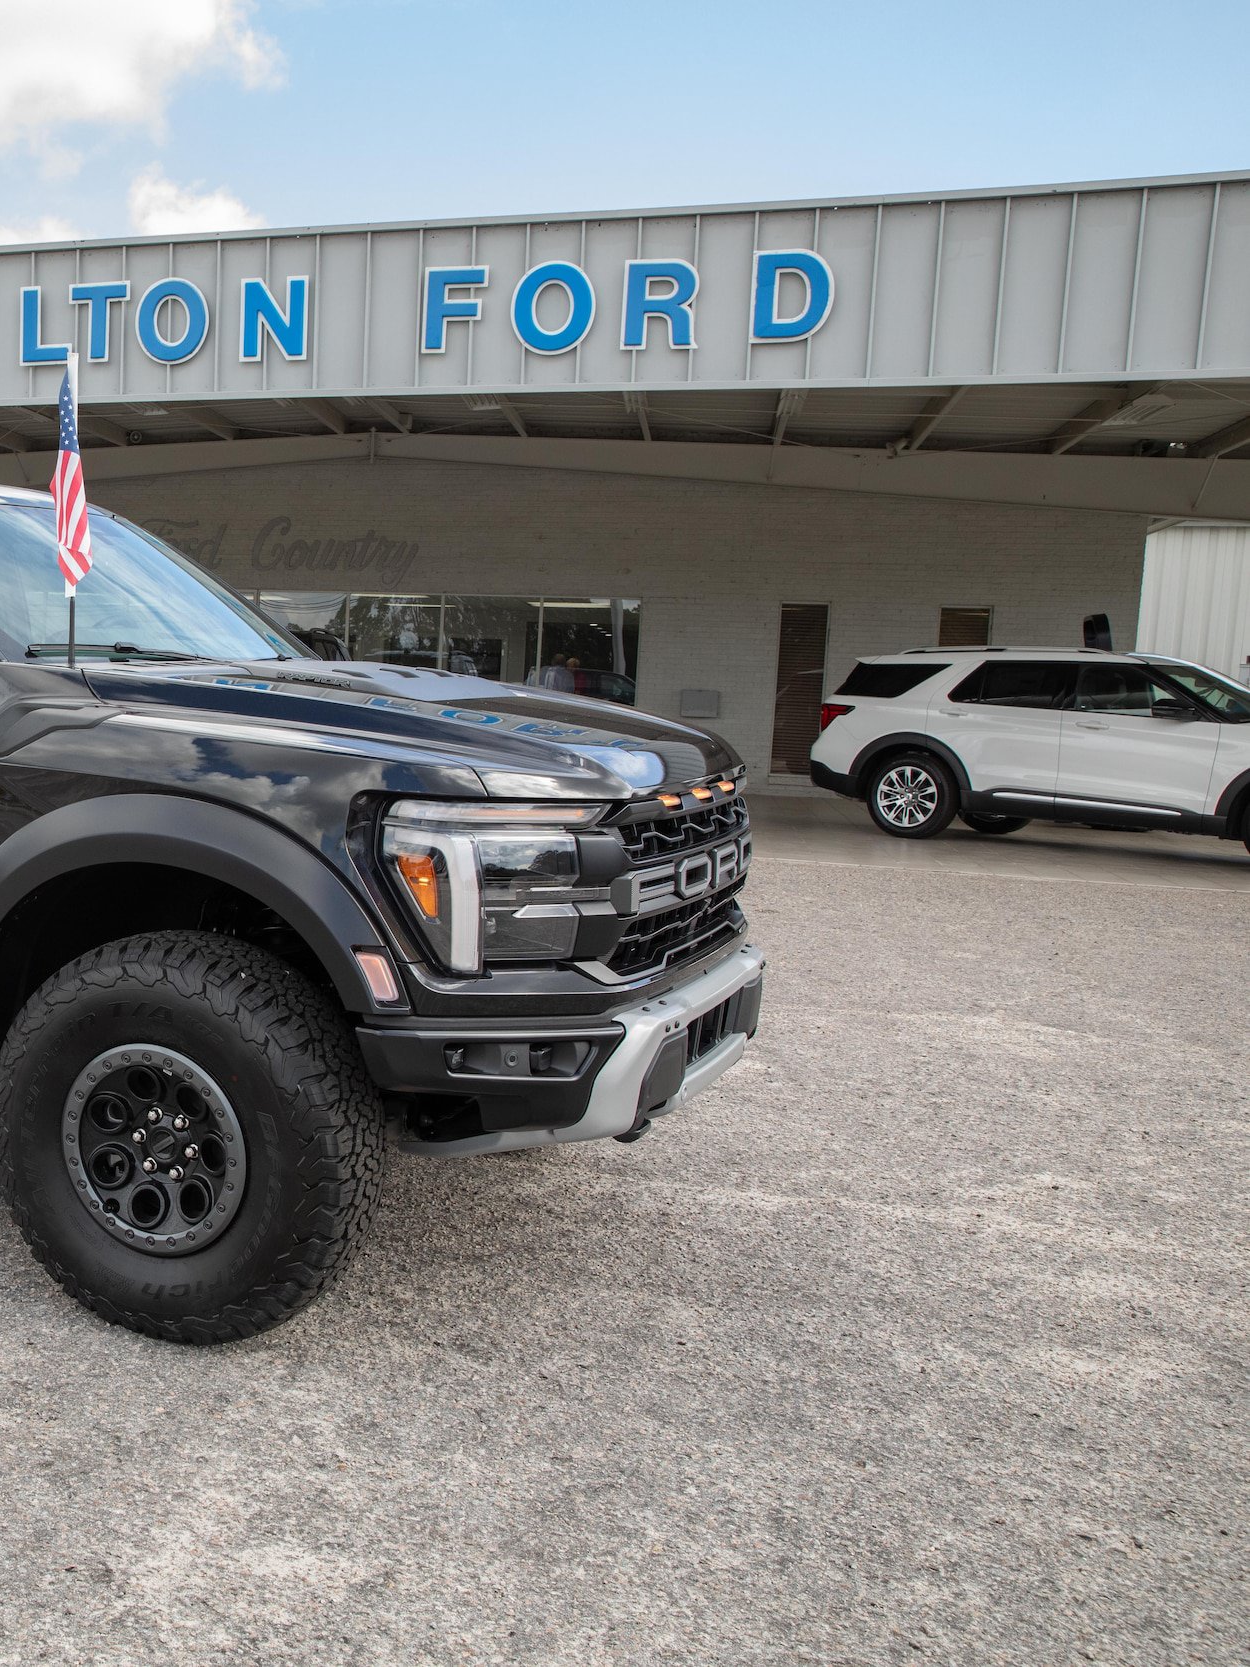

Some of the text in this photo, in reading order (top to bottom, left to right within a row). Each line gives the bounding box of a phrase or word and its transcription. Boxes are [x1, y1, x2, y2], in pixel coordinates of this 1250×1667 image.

[421, 249, 835, 356] FORD
[250, 516, 420, 590] Country
[277, 671, 351, 689] RAPTOR
